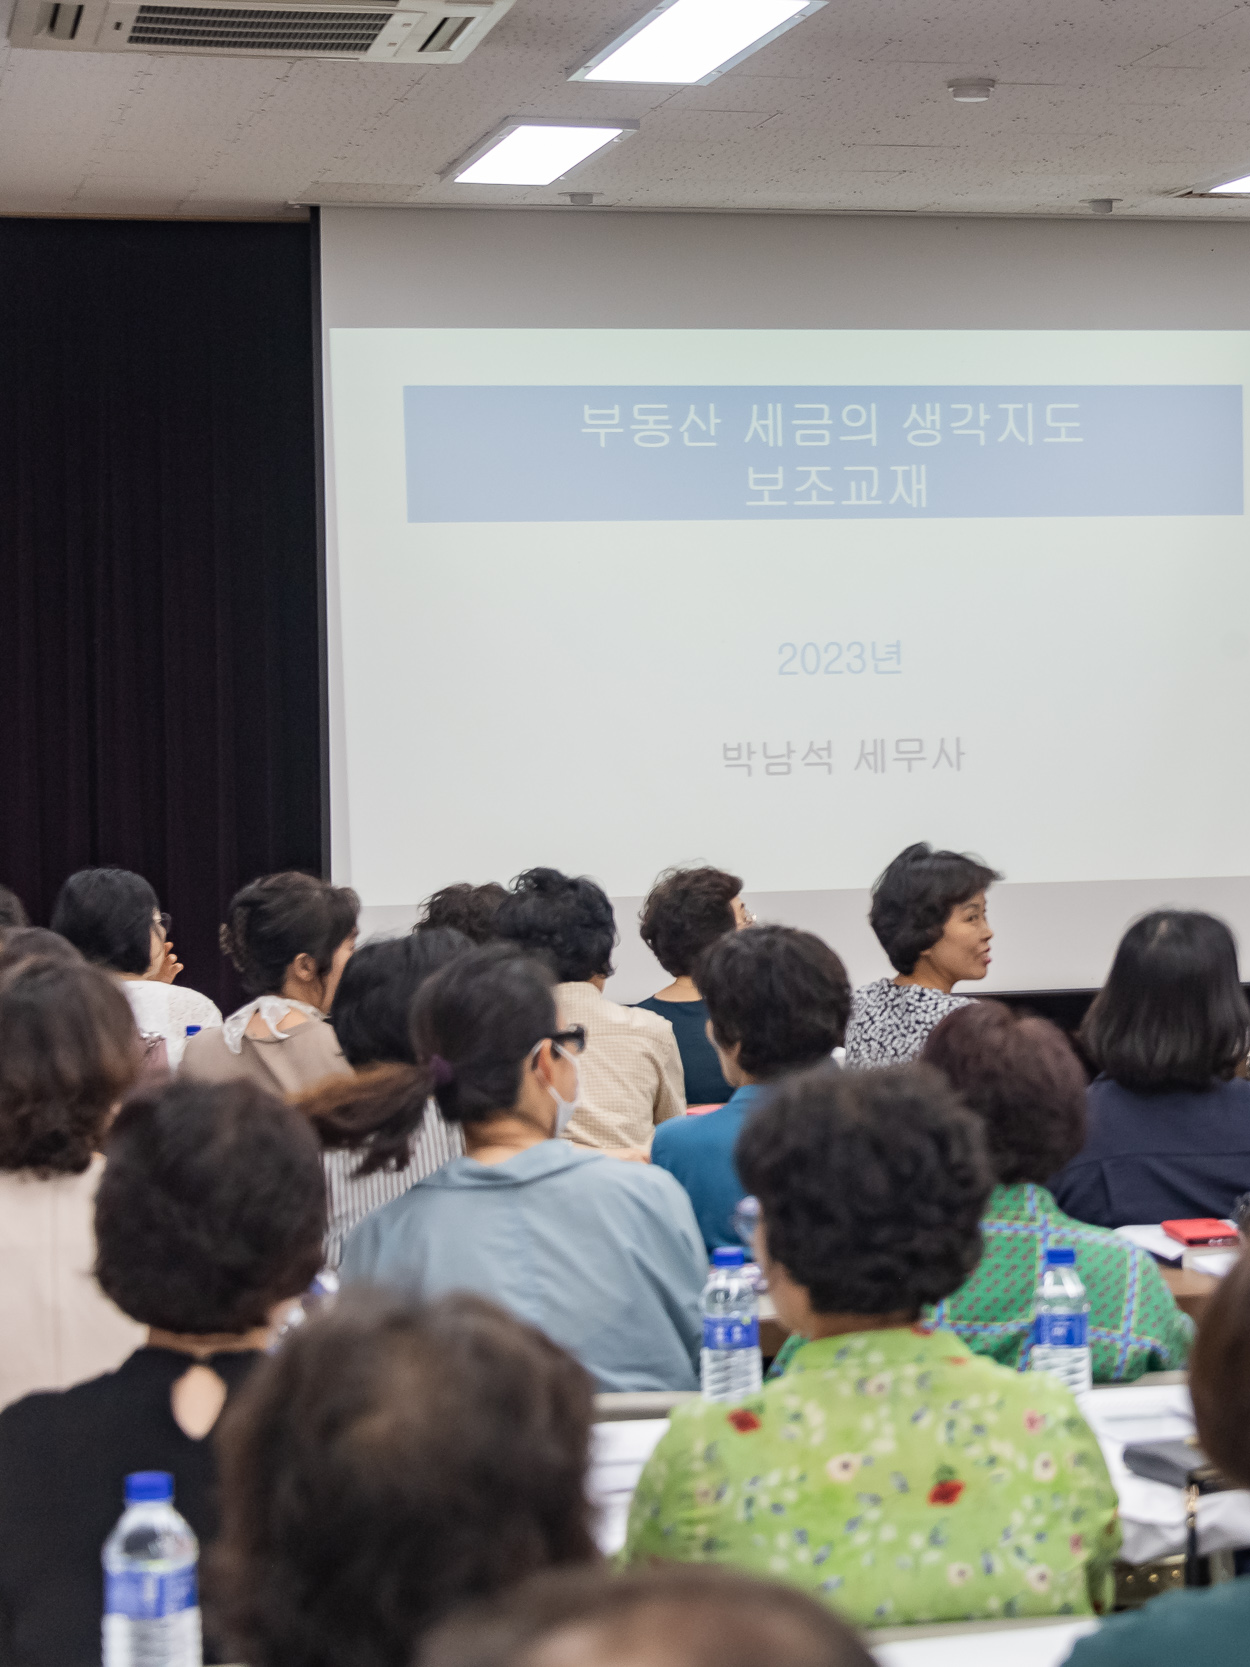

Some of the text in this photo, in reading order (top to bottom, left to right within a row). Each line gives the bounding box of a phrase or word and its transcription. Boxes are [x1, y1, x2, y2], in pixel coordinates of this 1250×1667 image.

[581, 402, 1084, 448] 부동산 세금의 생각지도
[746, 464, 927, 508] 보조교재
[777, 639, 903, 676] 2023년
[722, 736, 966, 777] 박남석 세무사
